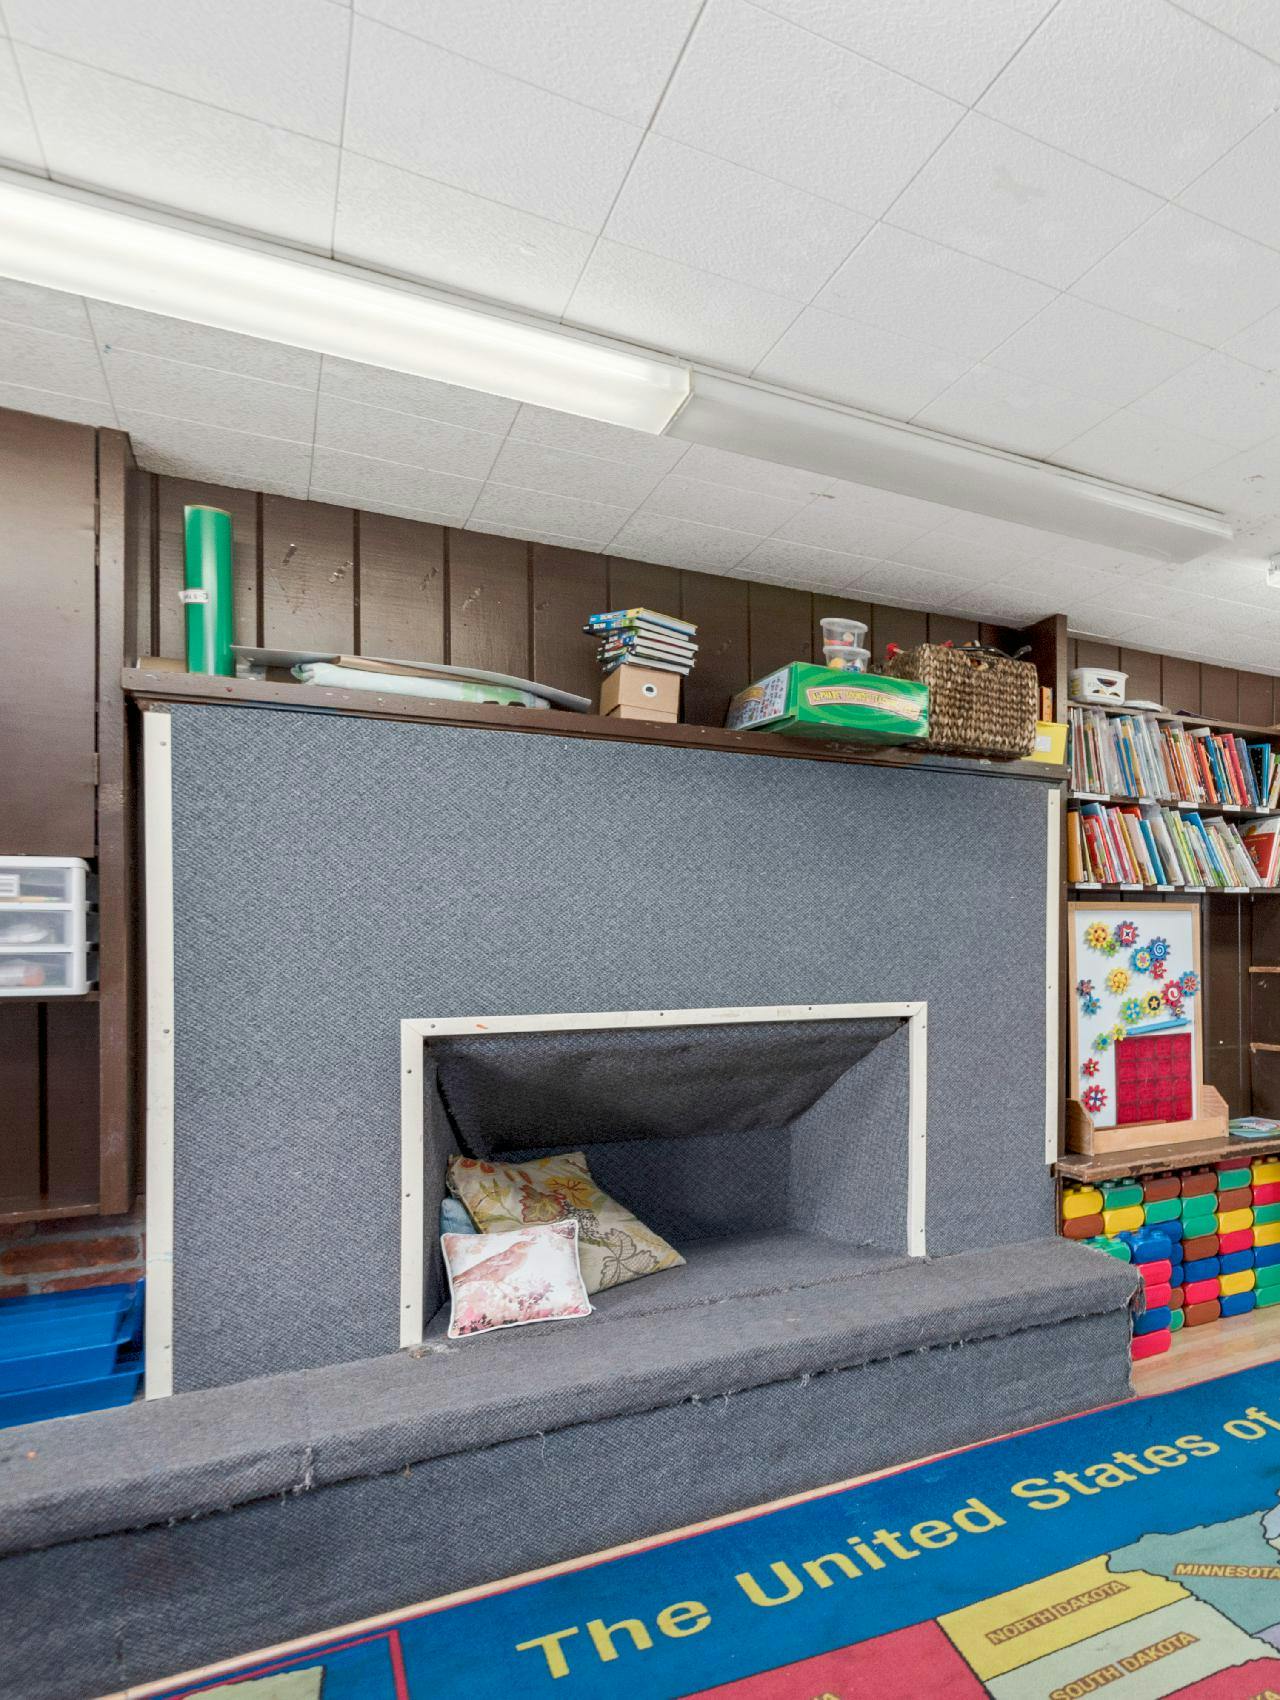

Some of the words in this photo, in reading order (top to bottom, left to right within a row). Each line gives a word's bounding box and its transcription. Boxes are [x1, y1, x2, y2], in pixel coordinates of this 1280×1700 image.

[515, 1600, 711, 1679] The
[735, 1498, 1007, 1607] United
[1011, 1433, 1220, 1511] States
[985, 1606, 1055, 1646] NORTH
[1053, 1580, 1131, 1616] DAKOTA
[1049, 1664, 1124, 1700] SOUTH
[1117, 1631, 1200, 1673] DAKOTA
